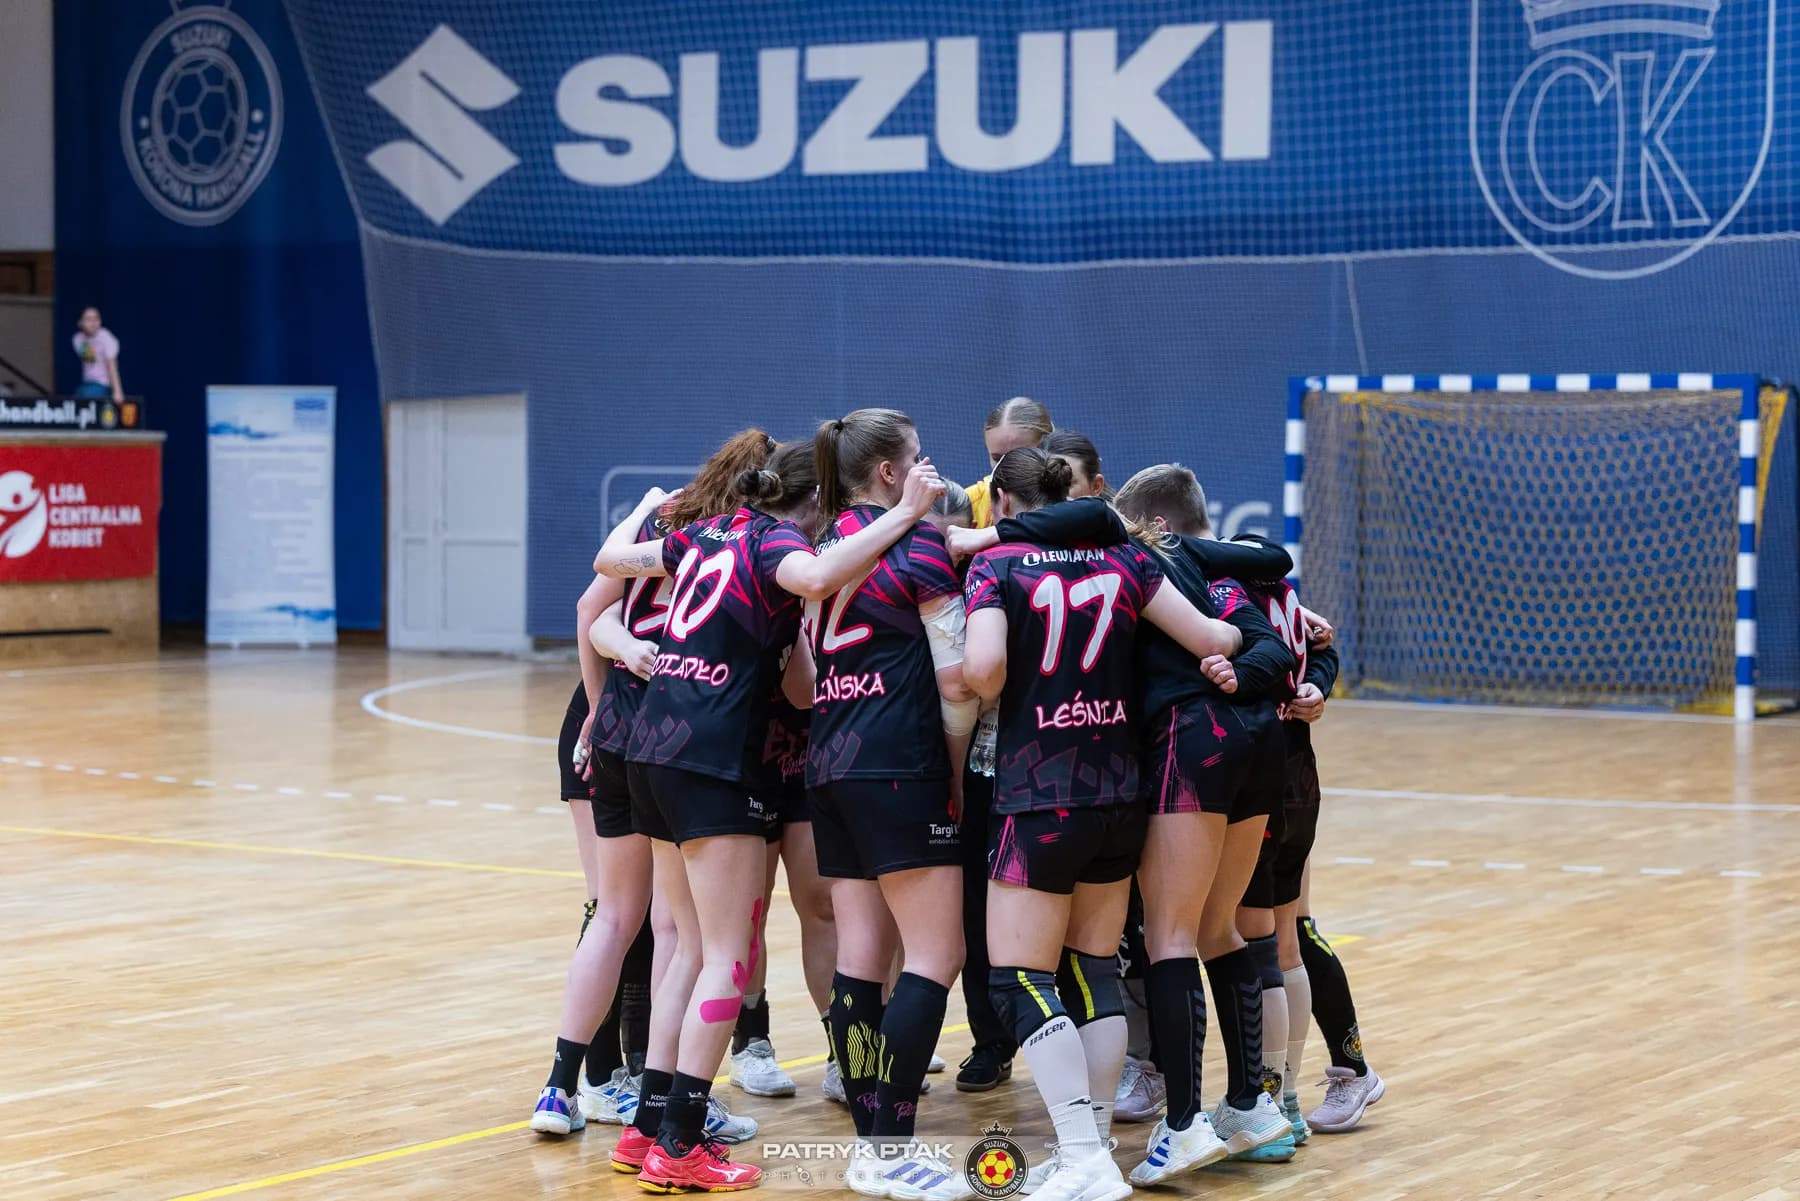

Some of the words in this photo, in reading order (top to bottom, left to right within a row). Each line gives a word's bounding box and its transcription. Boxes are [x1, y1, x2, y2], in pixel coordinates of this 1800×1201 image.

[553, 20, 1273, 187] SUZUKI
[1500, 46, 1716, 232] CK
[48, 483, 87, 504] LIGA
[49, 505, 143, 526] CENTRALNA
[48, 527, 104, 548] KOBIET
[660, 546, 736, 642] 10
[1030, 571, 1124, 676] 17
[1036, 690, 1127, 729] LEŚNIA
